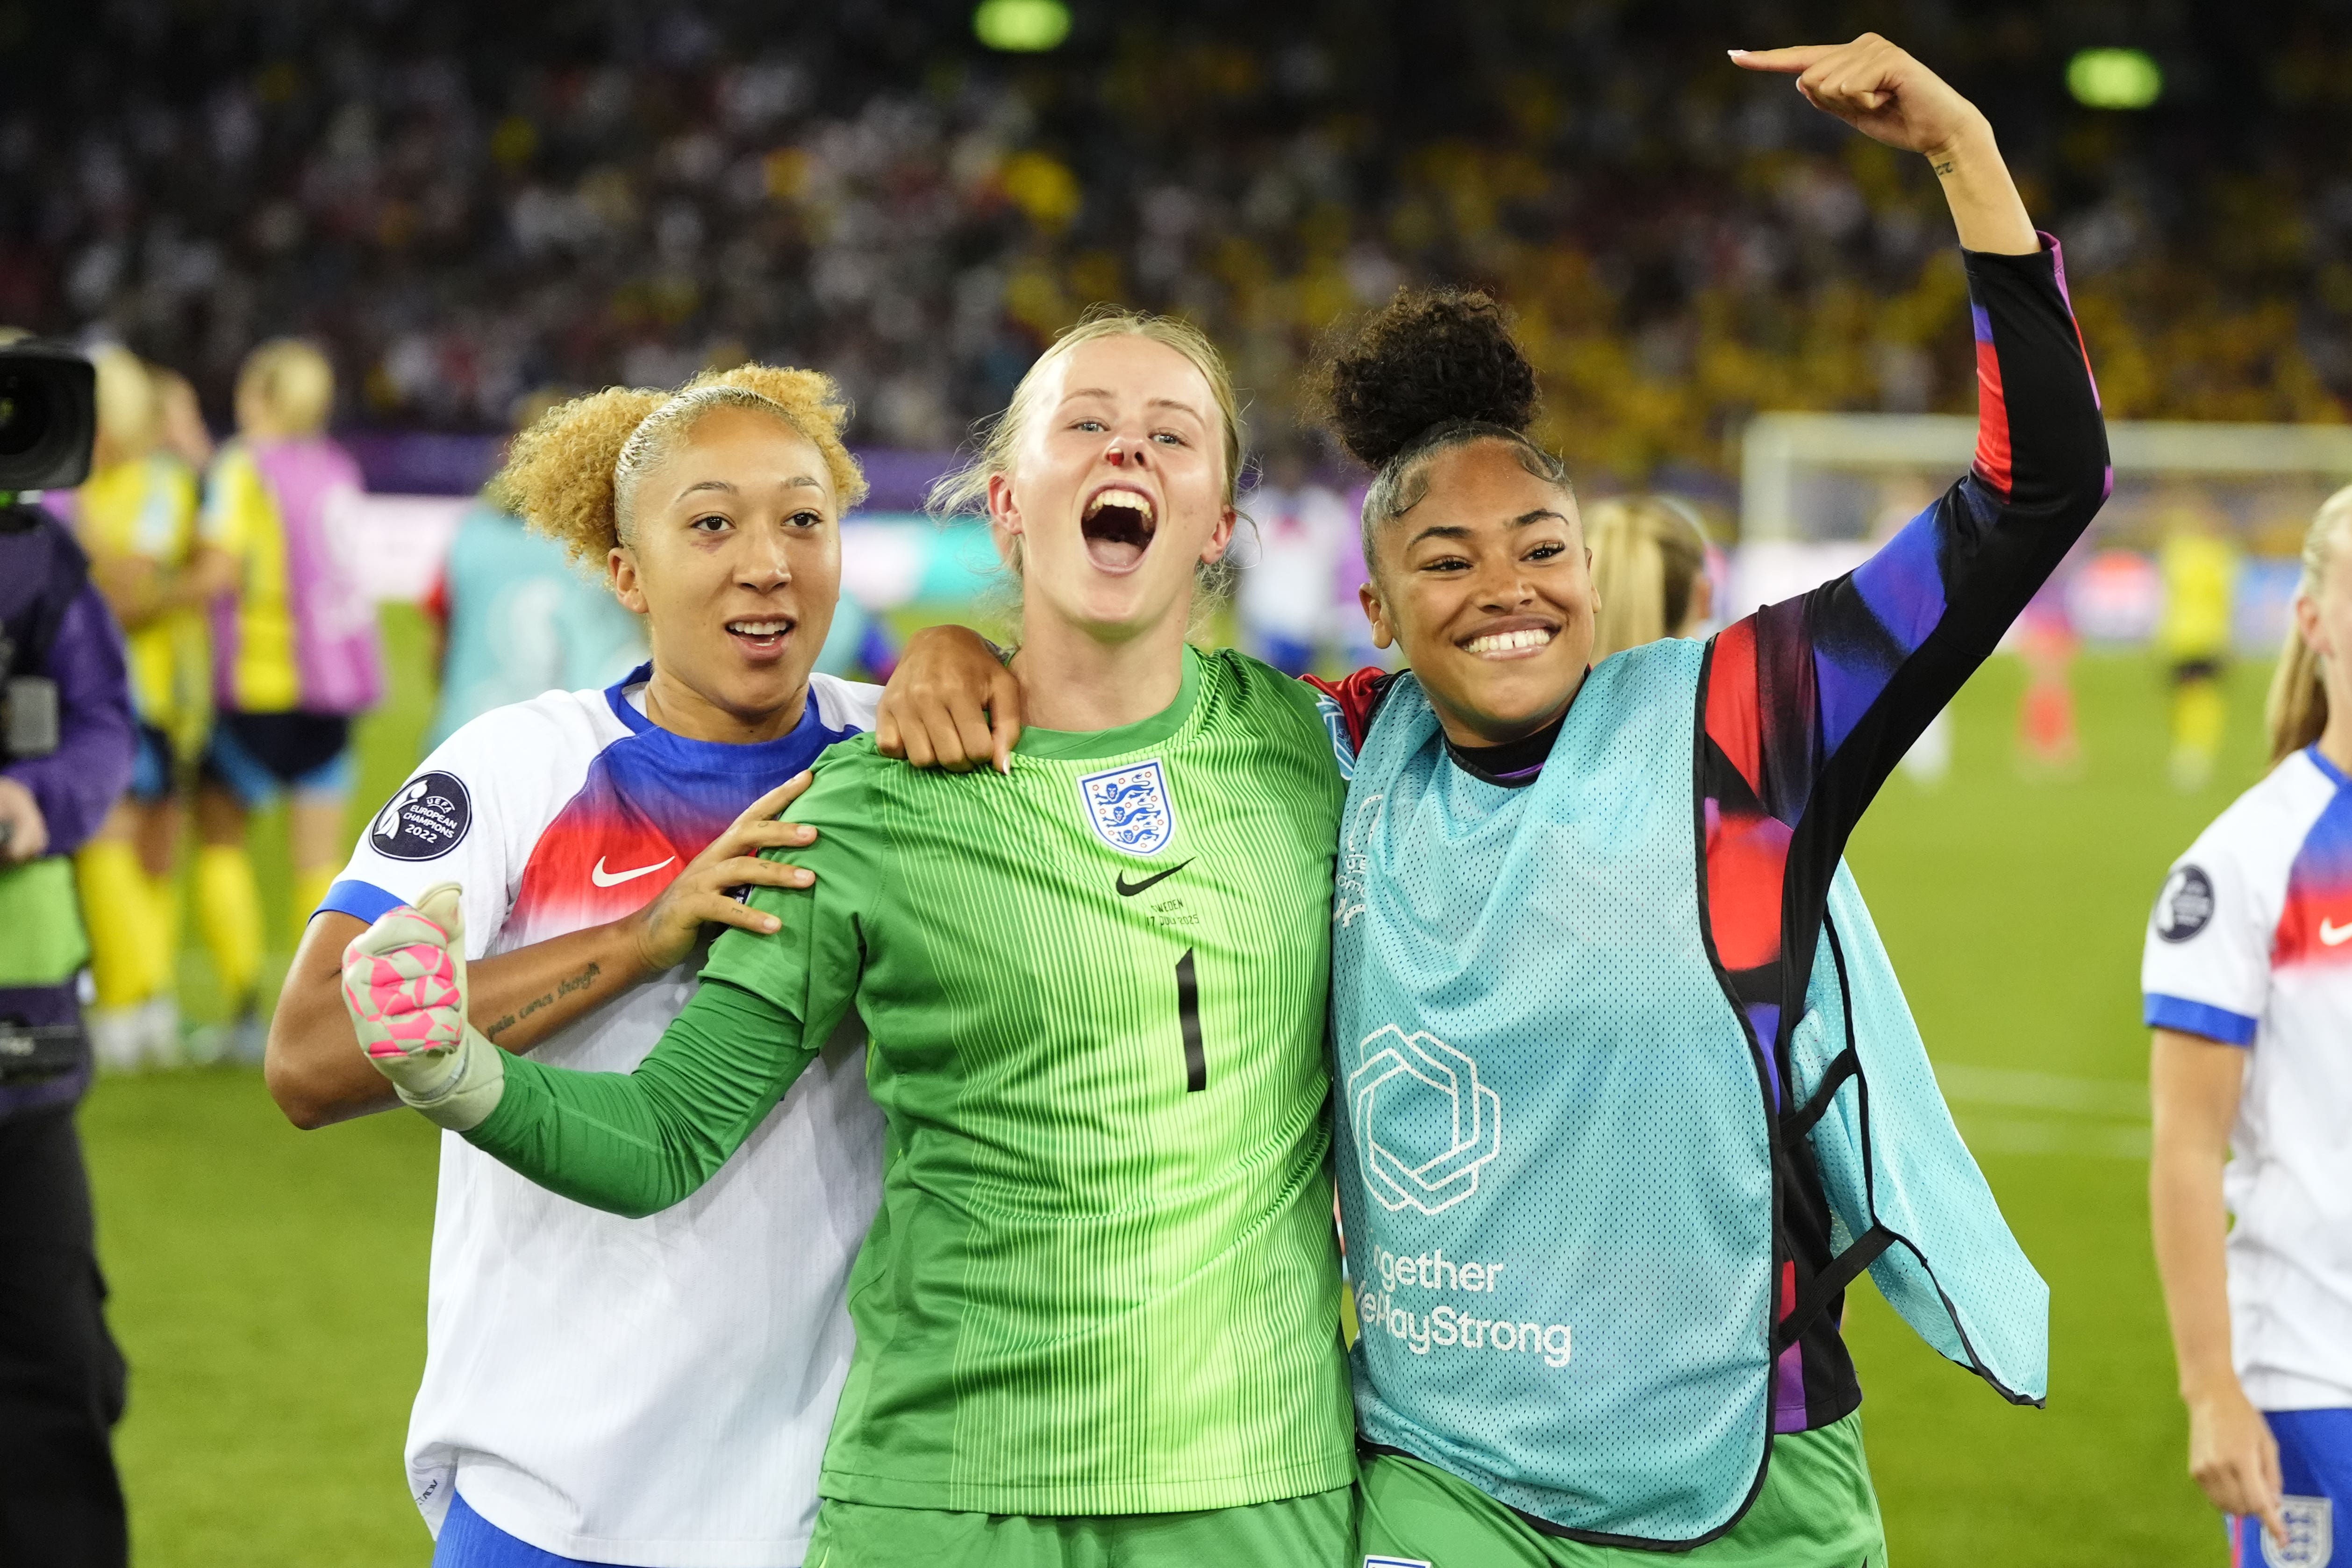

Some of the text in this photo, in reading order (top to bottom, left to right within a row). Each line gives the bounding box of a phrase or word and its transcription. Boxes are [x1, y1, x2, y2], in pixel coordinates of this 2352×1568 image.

[426, 798, 452, 813] UEFA
[403, 812, 454, 838] CHAMPIONS
[410, 805, 458, 830] EUROPEAN
[405, 824, 437, 844] 2022
[1151, 898, 1183, 912] SWEDEN
[1177, 914, 1200, 925] 2025
[1175, 946, 1207, 1092] 1
